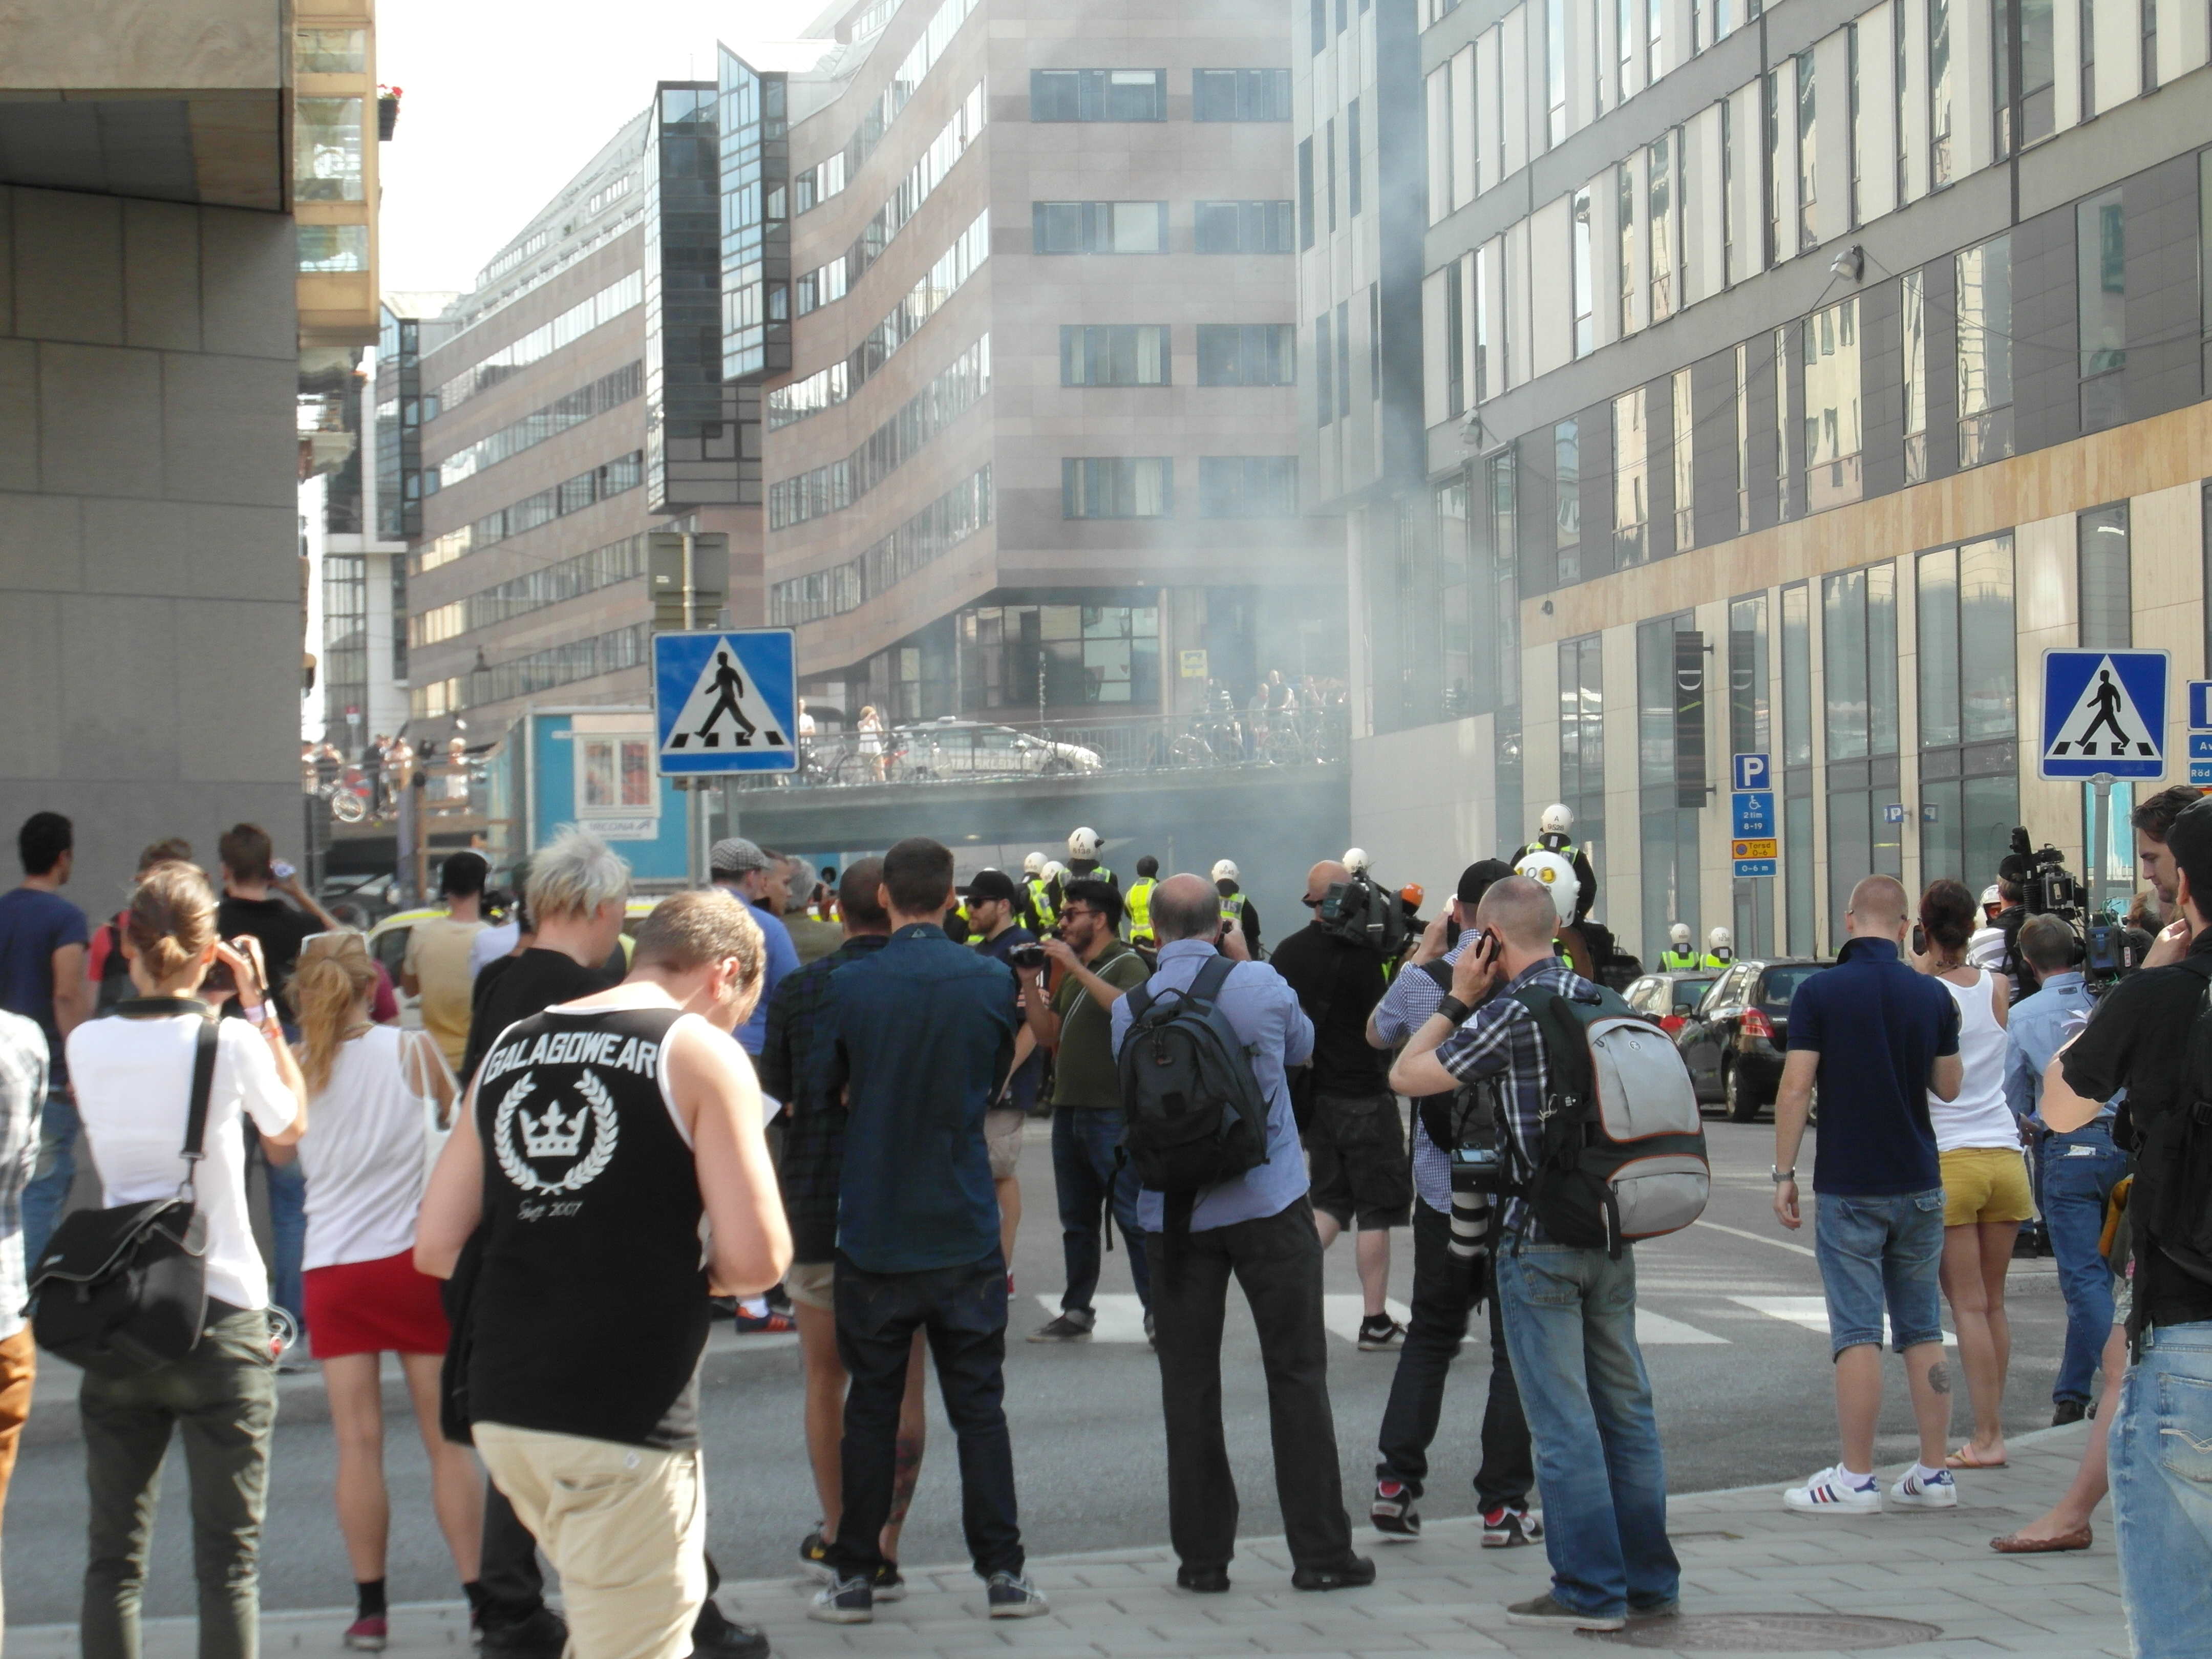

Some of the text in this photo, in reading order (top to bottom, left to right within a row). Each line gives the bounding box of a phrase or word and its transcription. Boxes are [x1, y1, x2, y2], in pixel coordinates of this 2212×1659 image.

[1744, 757, 1763, 786] P
[1890, 807, 1901, 820] P
[483, 1031, 659, 1085] GALAGOWEAR
